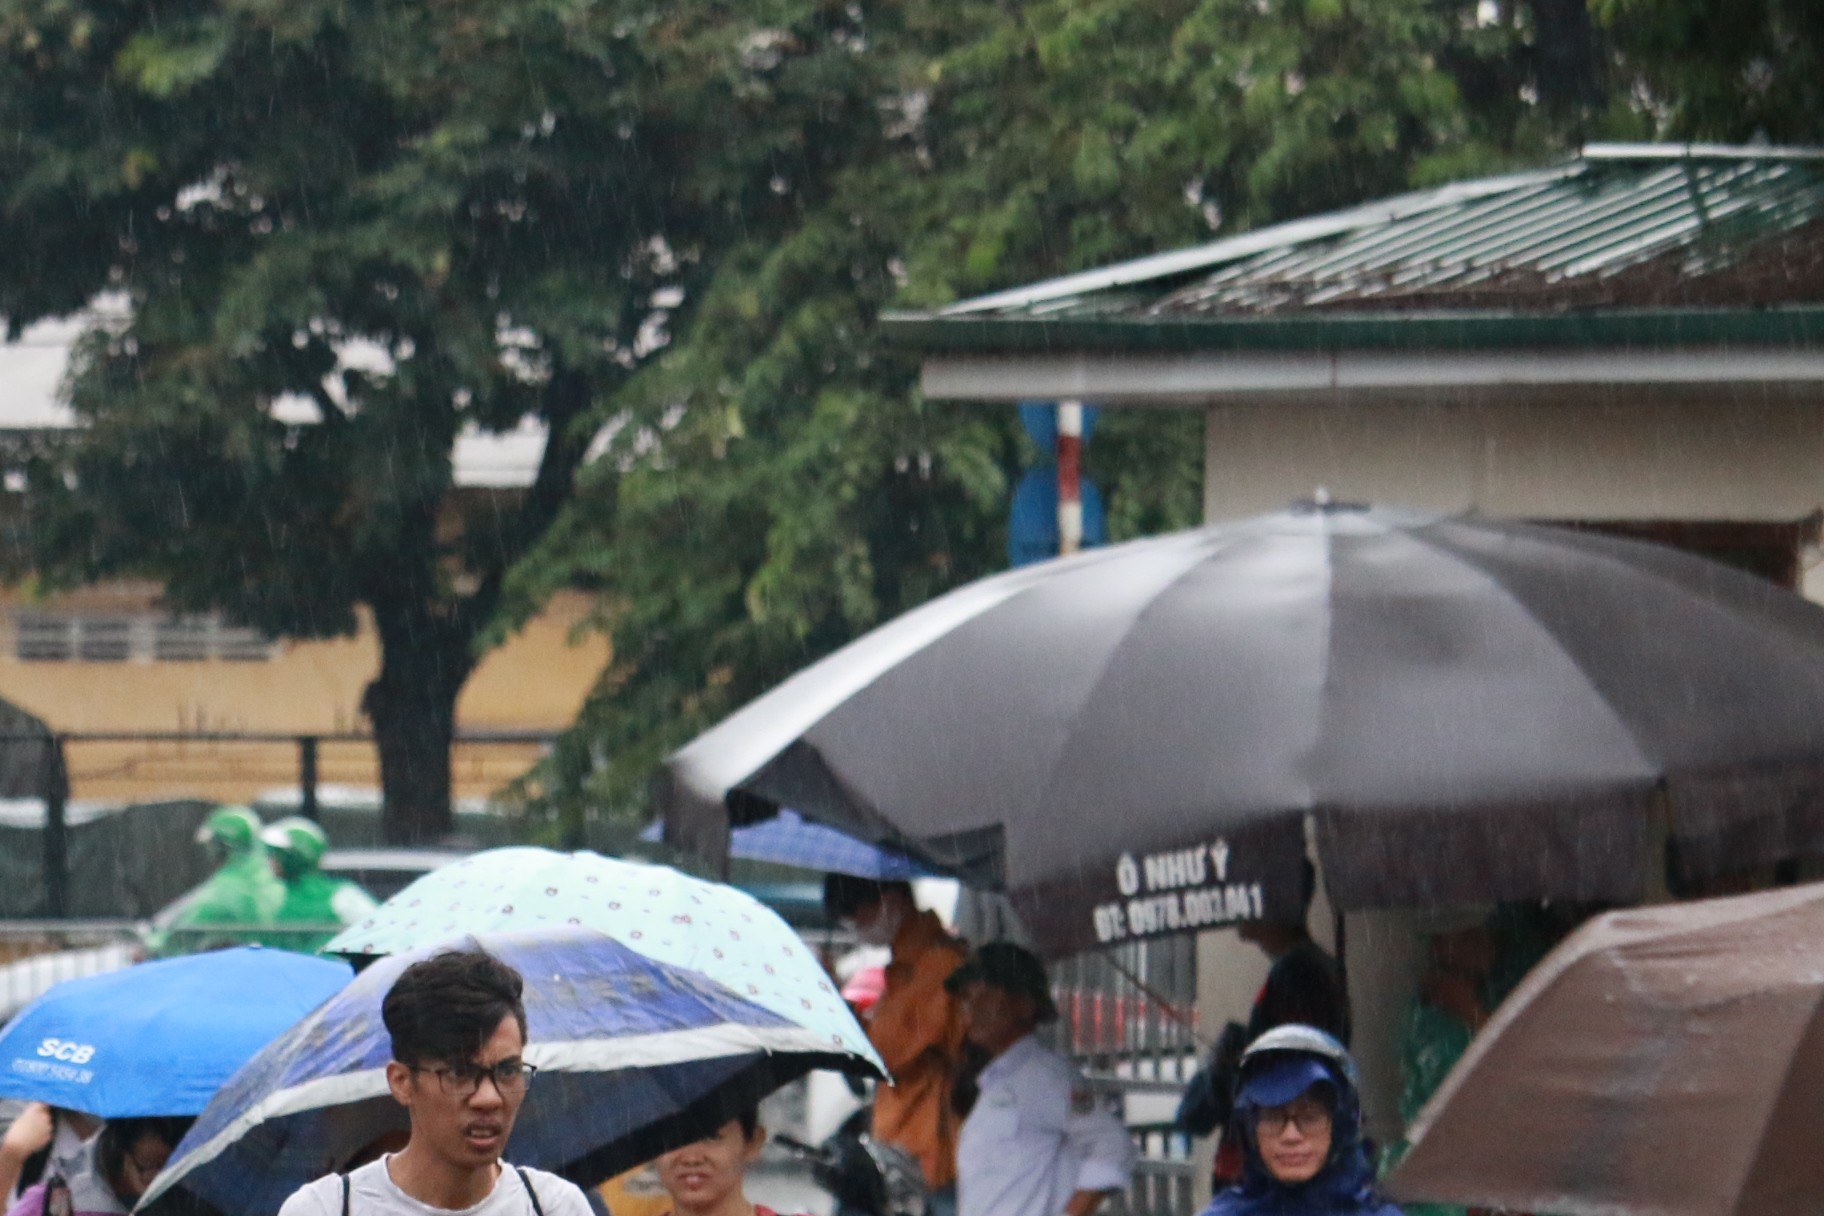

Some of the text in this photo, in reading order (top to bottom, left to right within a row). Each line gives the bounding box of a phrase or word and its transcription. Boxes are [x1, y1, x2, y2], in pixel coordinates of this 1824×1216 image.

[1116, 851, 1139, 896] Ô
[1144, 844, 1207, 892] NHƯ
[37, 1038, 95, 1064] SCB
